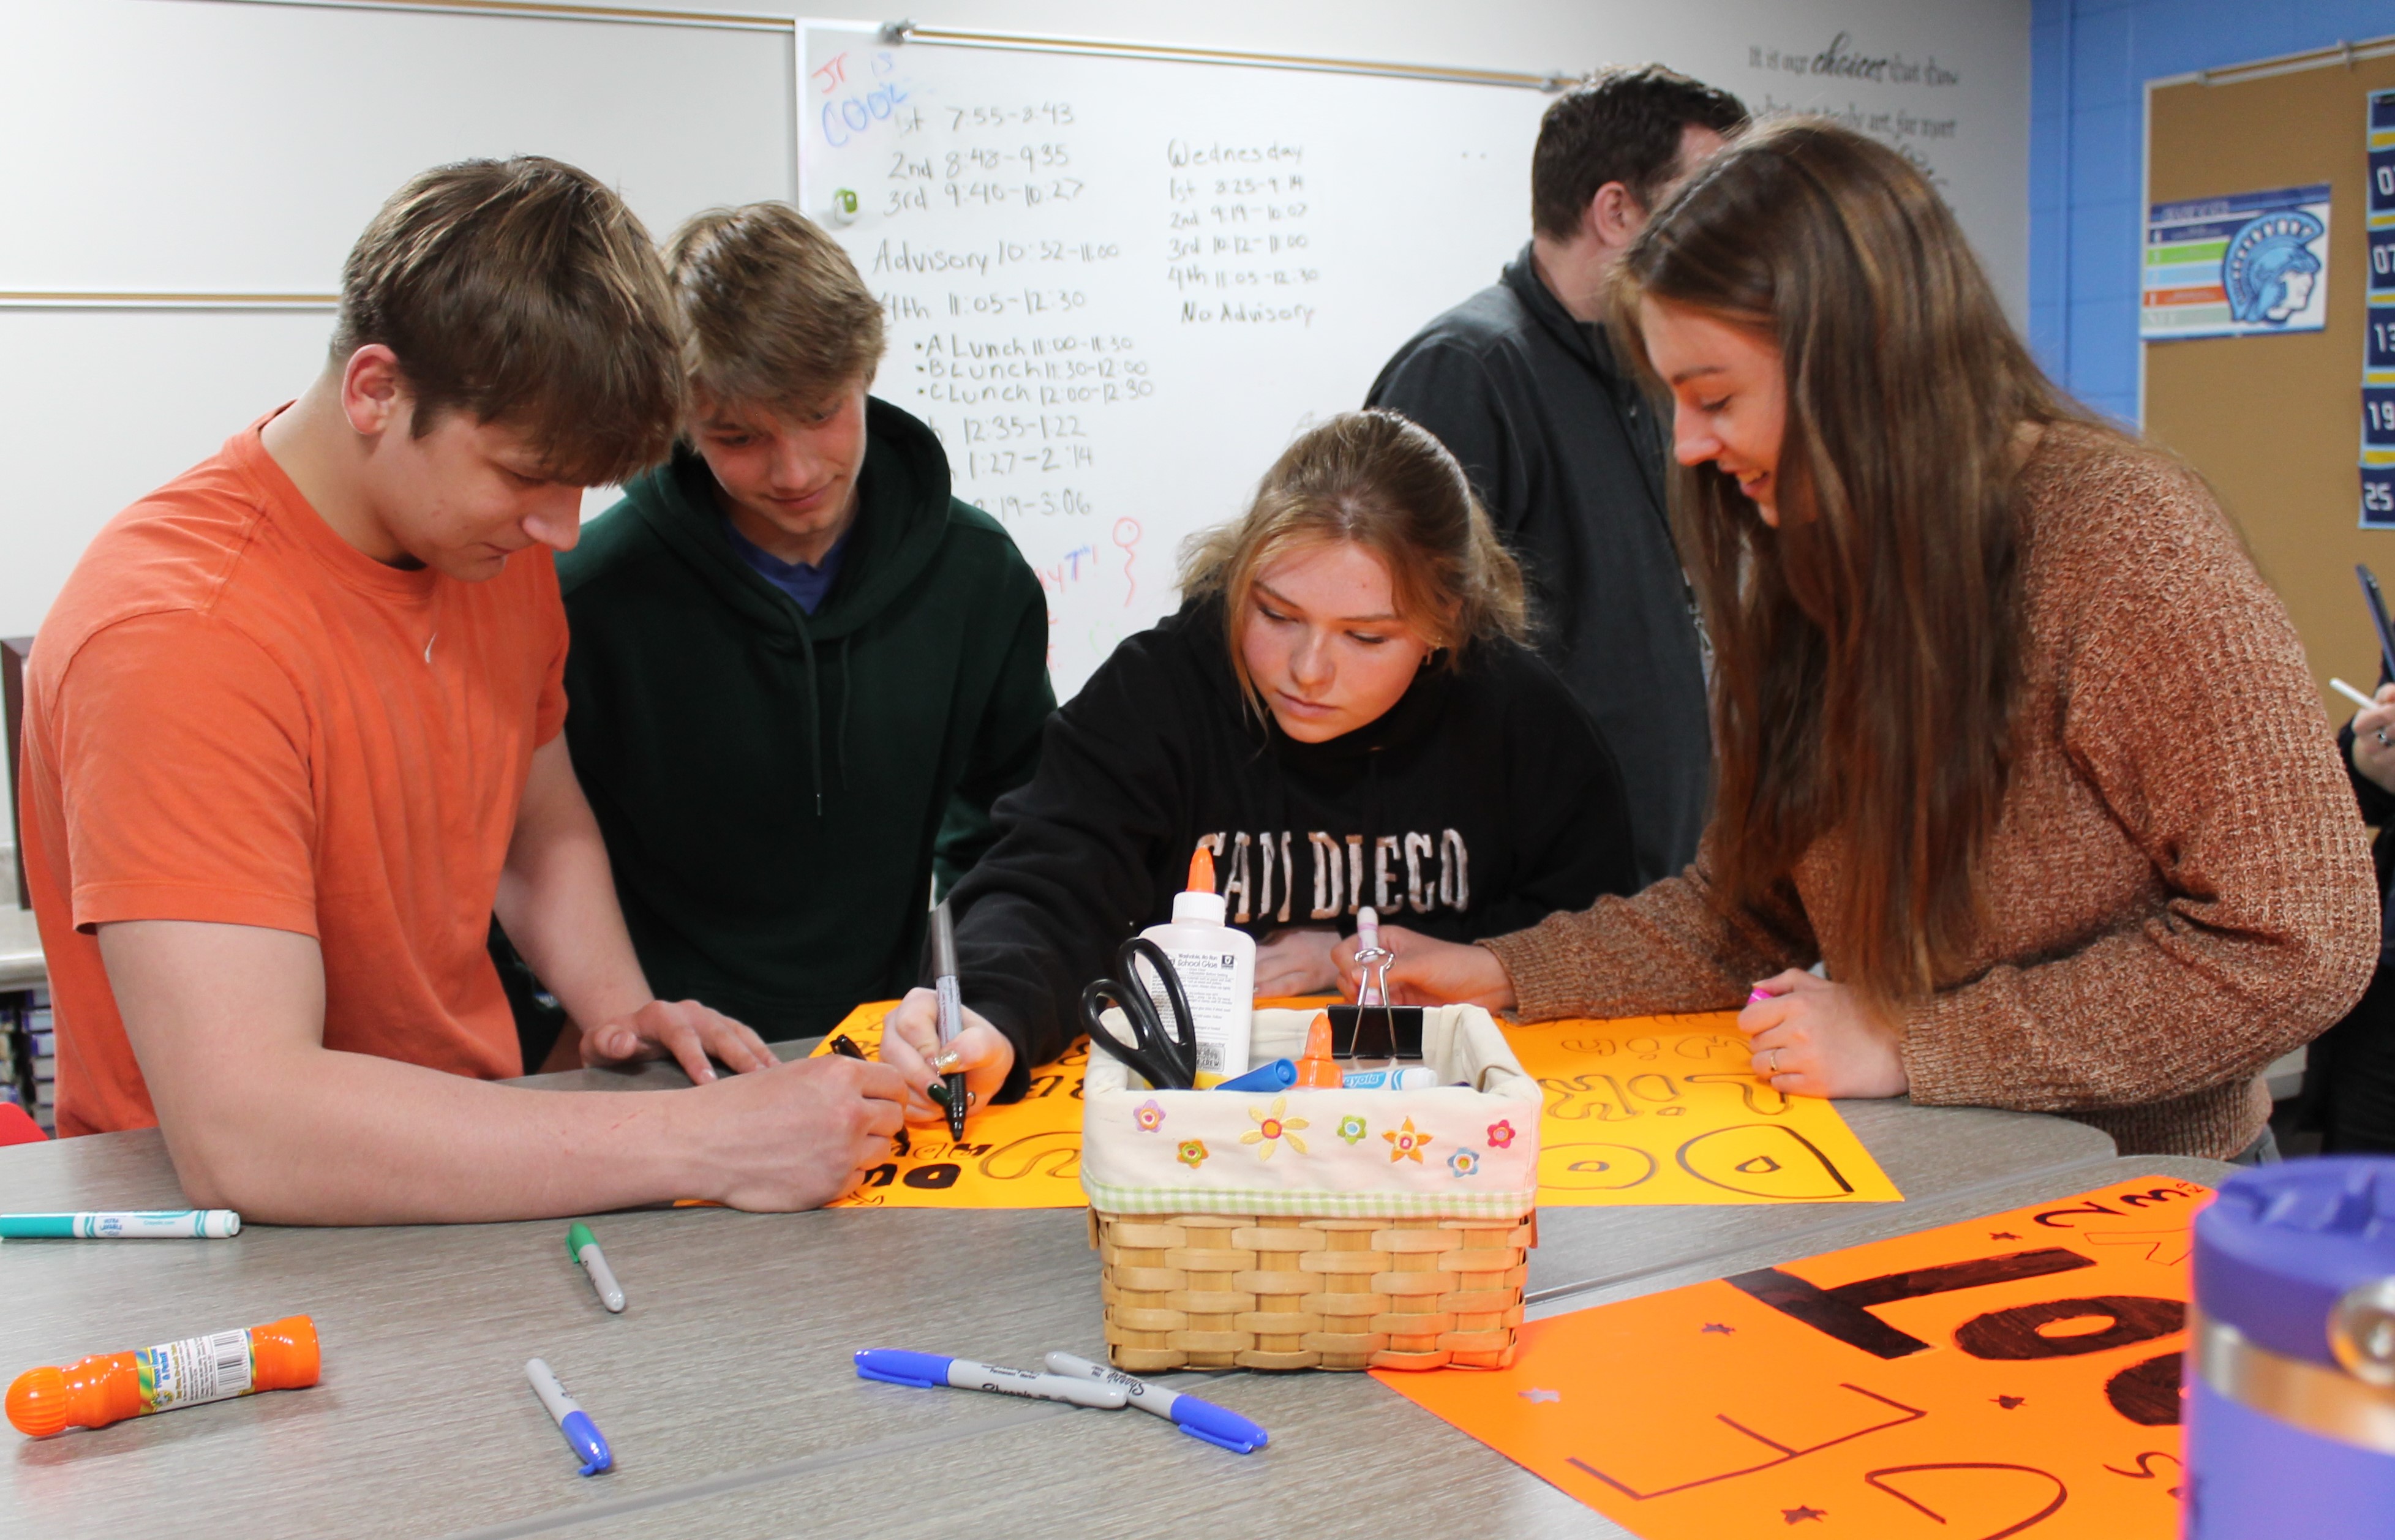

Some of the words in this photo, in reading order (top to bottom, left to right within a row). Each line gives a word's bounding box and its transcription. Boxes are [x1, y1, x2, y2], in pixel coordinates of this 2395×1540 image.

[888, 152, 933, 180] 2nd
[1168, 138, 1303, 168] Wednesday
[883, 186, 928, 216] 3rd
[1170, 210, 1199, 230] 2nd
[873, 238, 987, 276] Advisory
[1167, 235, 1200, 261] 3rd
[1168, 265, 1207, 291] 4th
[1181, 300, 1211, 323] No
[1221, 302, 1315, 329] Advisory
[926, 334, 942, 357] A
[951, 334, 1025, 359] Lunch
[930, 359, 945, 378] B
[950, 359, 1040, 380] Lunch
[930, 382, 943, 400] C
[949, 383, 1029, 404] Lunch
[2364, 482, 2393, 512] 25
[1308, 828, 1470, 919] DIEGO
[1178, 958, 1201, 967] School
[1201, 960, 1218, 968] Glue
[1342, 1074, 1380, 1088] ayola
